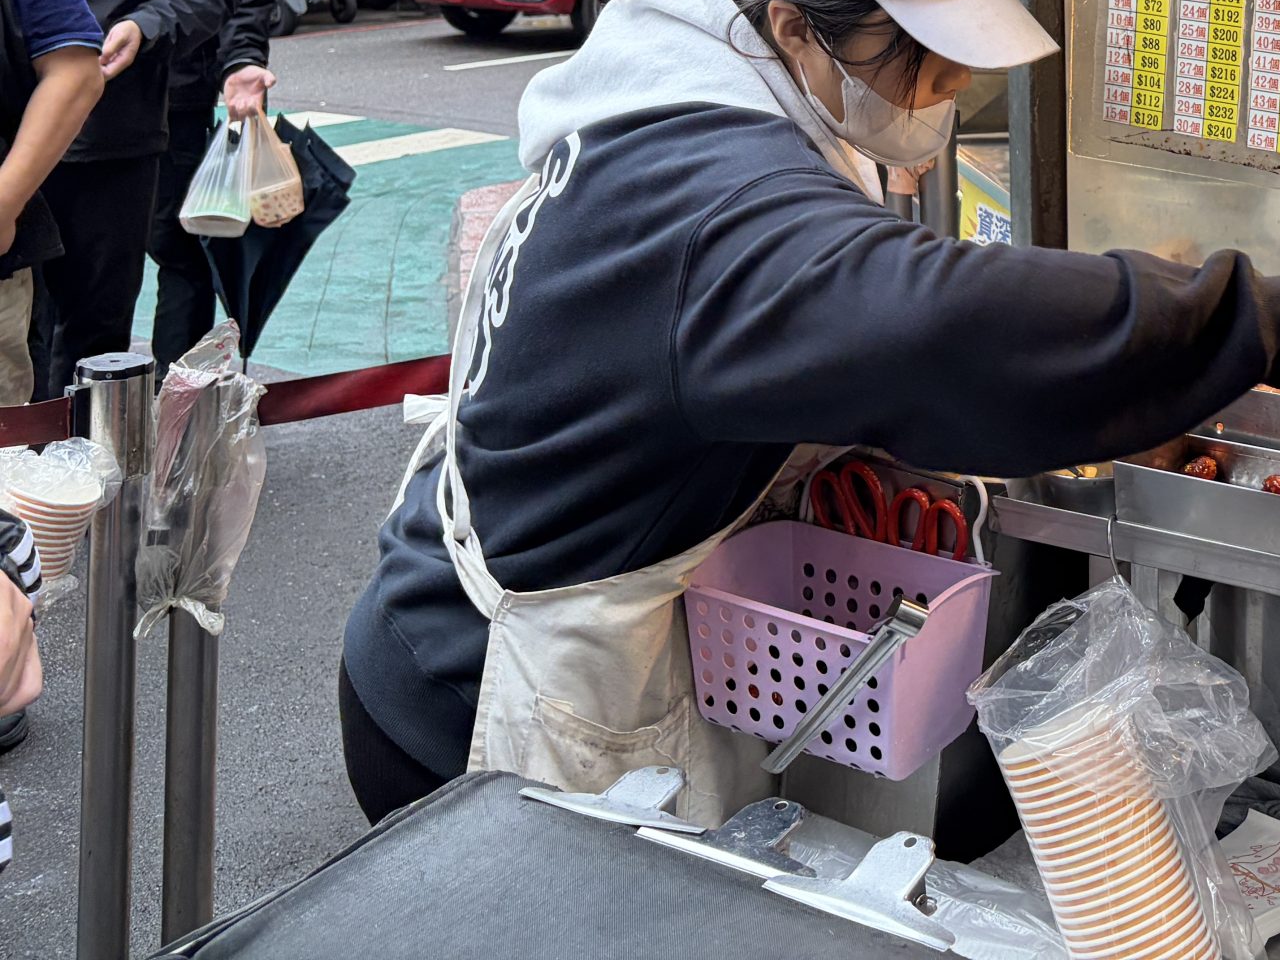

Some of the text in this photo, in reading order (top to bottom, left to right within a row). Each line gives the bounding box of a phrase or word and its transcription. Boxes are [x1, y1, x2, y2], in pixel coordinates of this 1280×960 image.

[1183, 3, 1239, 23] 24個 $192
[1142, 17, 1161, 31] $80
[1182, 22, 1238, 42] 25個 $200
[1141, 36, 1160, 50] $88
[1181, 42, 1237, 62] 26個 $208
[1256, 35, 1280, 50] 40個
[1140, 55, 1159, 69] $96
[1180, 61, 1235, 81] 27個 $216
[1255, 55, 1280, 70] 41個
[1108, 69, 1160, 89] 13個 $104
[1254, 75, 1279, 90] 42個
[1107, 88, 1159, 108] 14個 $112
[1179, 80, 1234, 101] 28個 $224
[1178, 100, 1233, 120] 29個 $232
[1253, 94, 1277, 110] 43個
[1106, 106, 1158, 127] 15個 $120
[1252, 114, 1276, 129] 44個
[1177, 119, 1232, 140] 30個 $240
[1250, 134, 1275, 149] 45個
